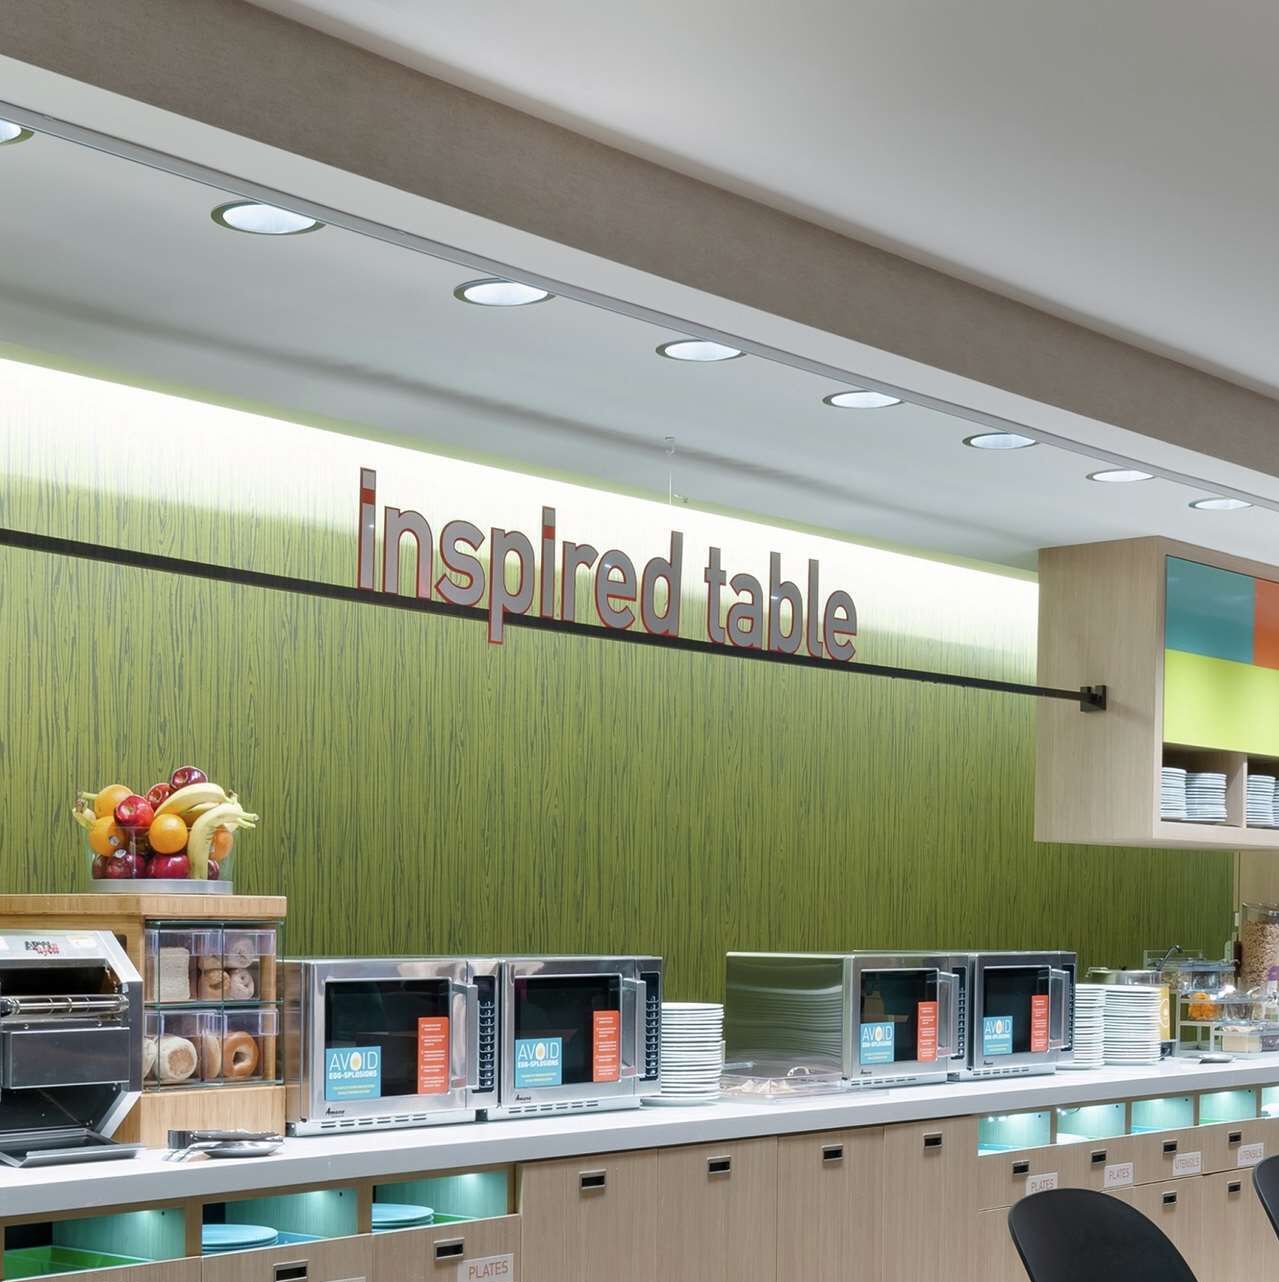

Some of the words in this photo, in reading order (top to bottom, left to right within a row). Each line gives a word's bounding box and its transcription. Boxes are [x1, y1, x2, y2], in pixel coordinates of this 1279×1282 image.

[357, 466, 684, 645] inspired
[704, 546, 858, 662] table
[862, 1026, 893, 1041] AVOID
[518, 1042, 560, 1060] AVOID
[329, 1051, 378, 1071] AVOID
[1108, 1167, 1131, 1180] PLATES
[1030, 1177, 1055, 1192] PLATES
[468, 1260, 509, 1281] PLATES
